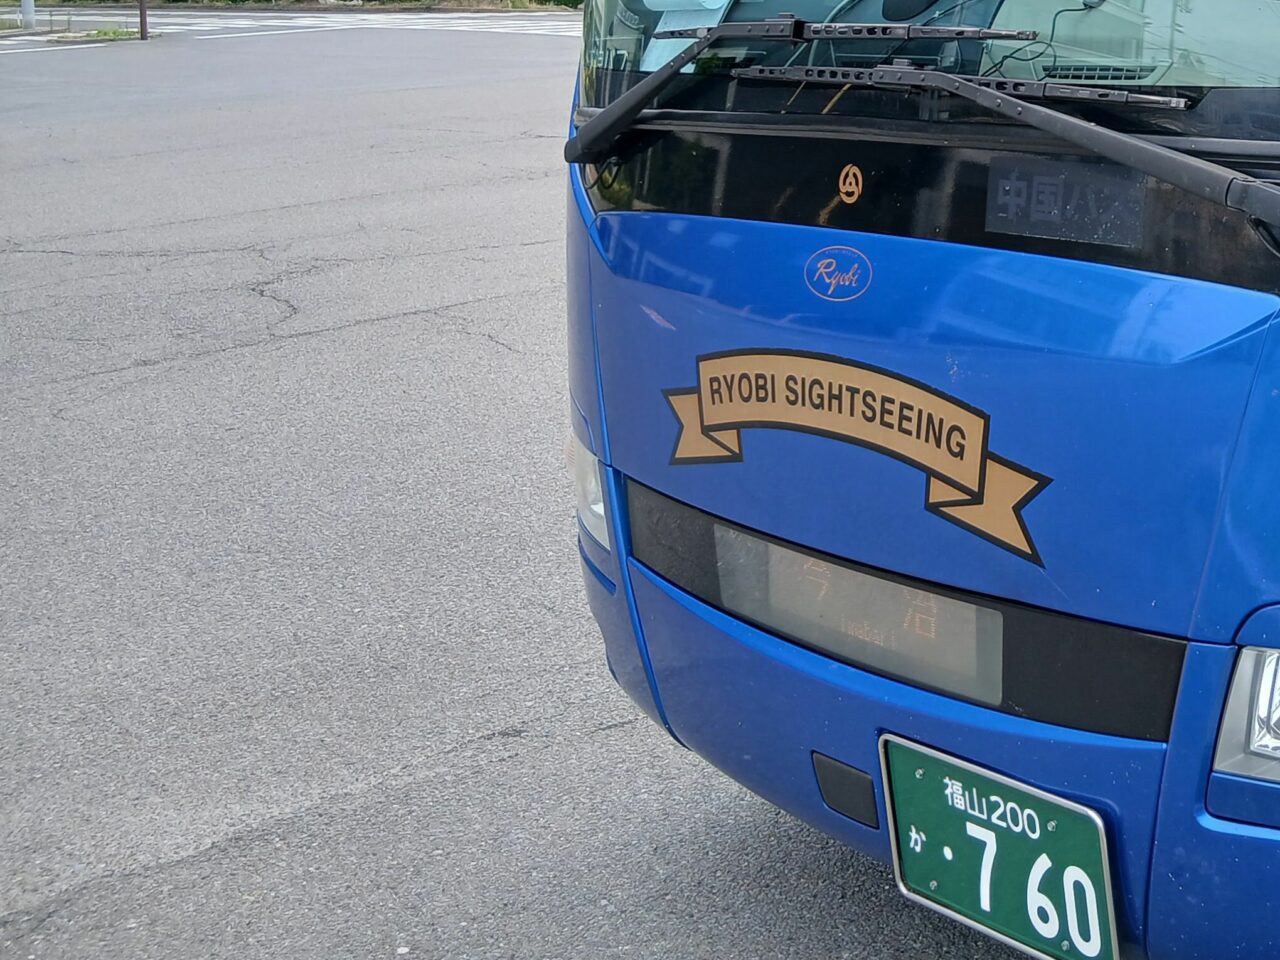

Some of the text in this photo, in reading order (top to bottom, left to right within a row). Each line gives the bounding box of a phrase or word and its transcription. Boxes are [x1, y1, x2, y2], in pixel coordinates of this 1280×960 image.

[813, 258, 860, 295] Ryobi
[708, 372, 967, 461] RYOBI SIGHTSEEING
[909, 825, 926, 853] か
